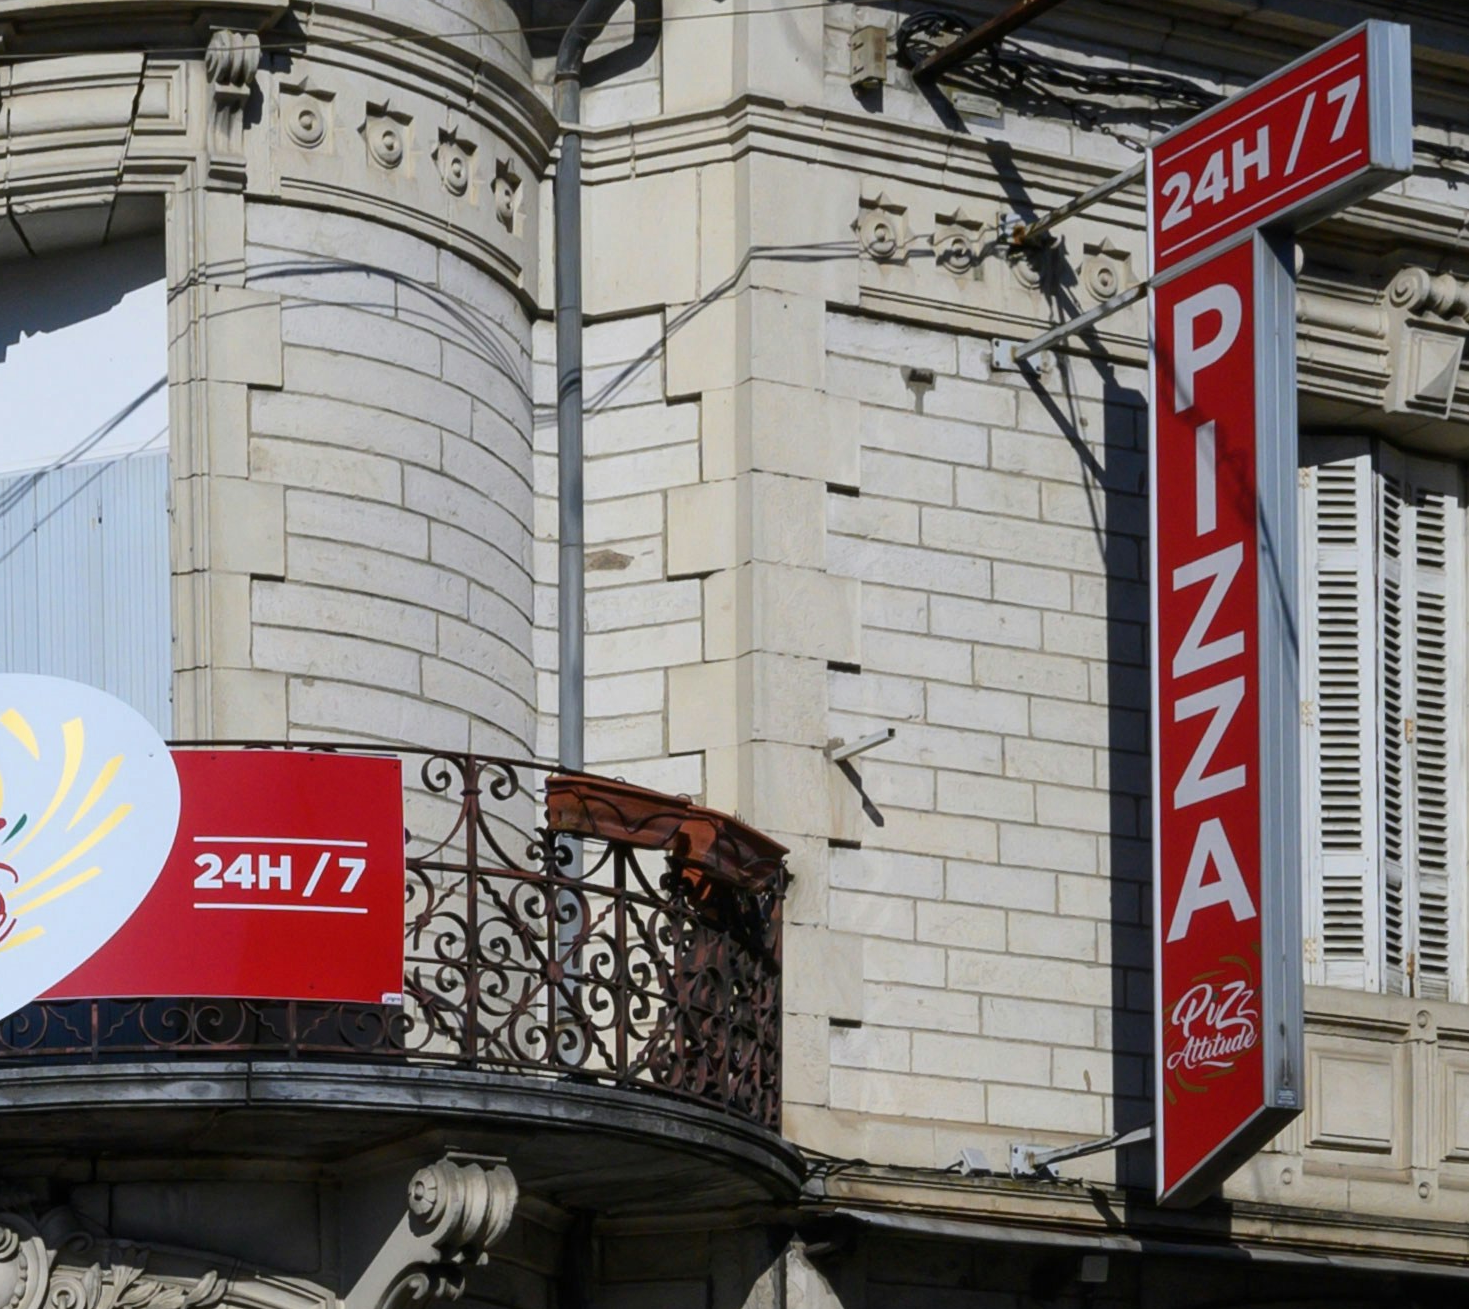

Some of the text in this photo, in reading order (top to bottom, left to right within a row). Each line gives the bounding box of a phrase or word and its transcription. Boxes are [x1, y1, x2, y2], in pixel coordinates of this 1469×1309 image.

[1161, 124, 1270, 232] 24H
[1166, 282, 1257, 944] PIZZA
[194, 853, 292, 891] 24H
[1166, 1026, 1257, 1070] Attitude
